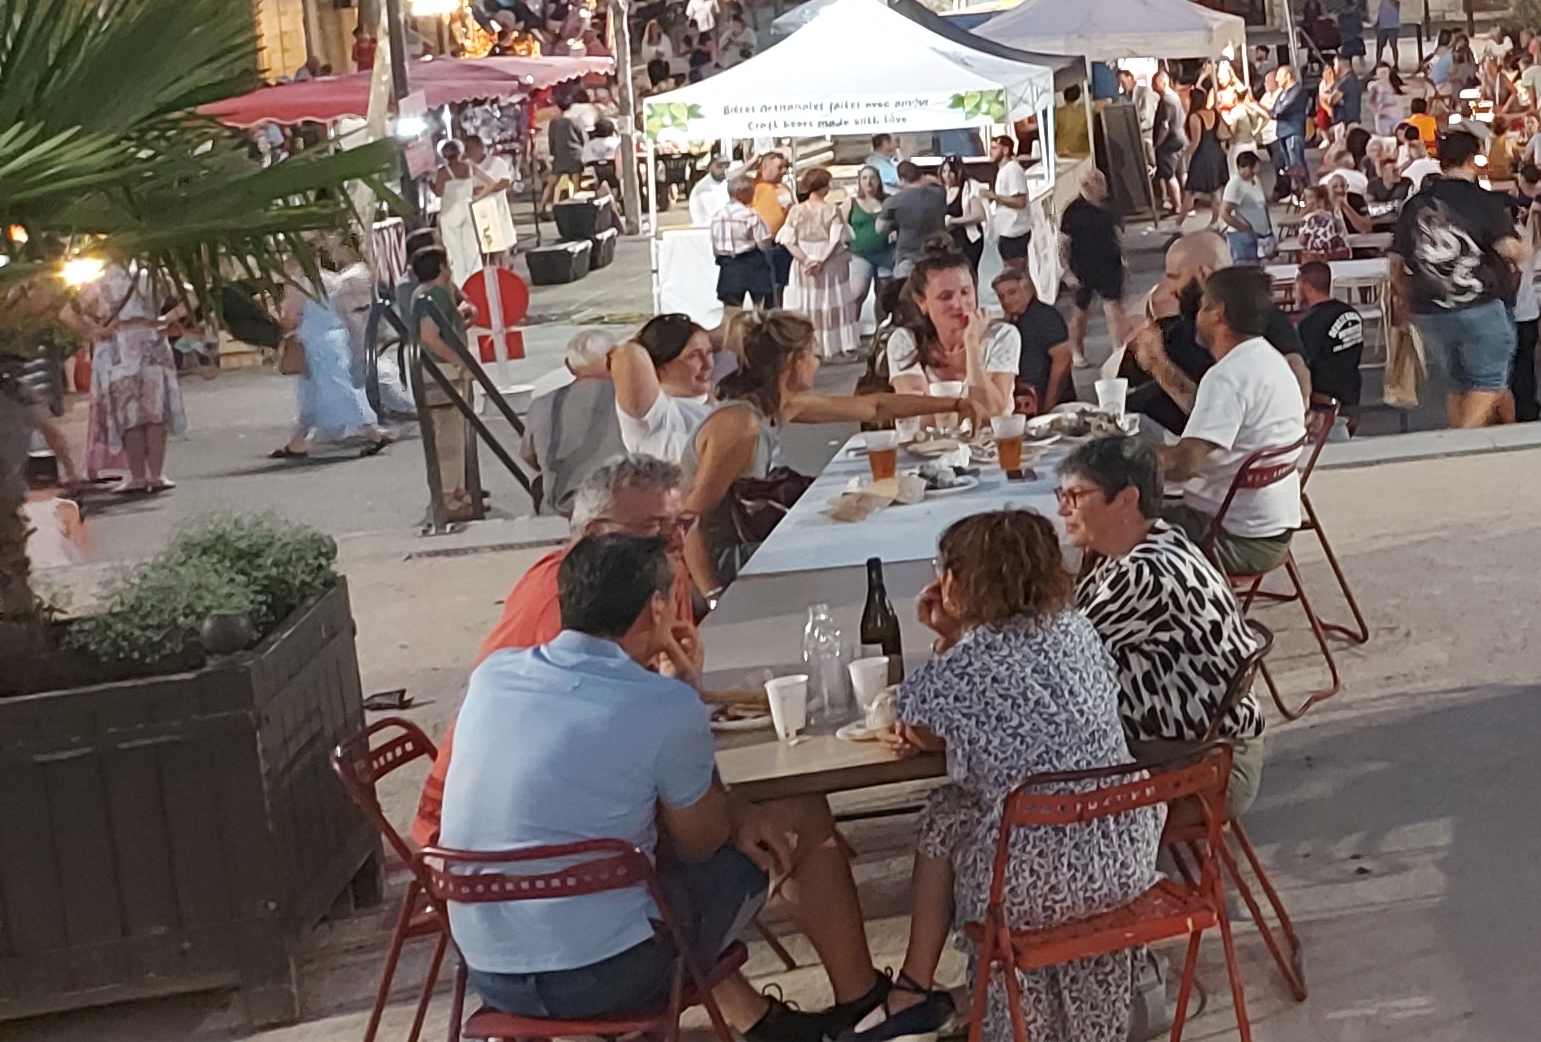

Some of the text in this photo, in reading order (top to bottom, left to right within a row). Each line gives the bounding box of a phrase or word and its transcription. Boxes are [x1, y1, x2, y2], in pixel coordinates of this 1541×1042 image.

[865, 101, 891, 109] avec
[748, 121, 778, 132] Craft
[818, 118, 850, 128] made
